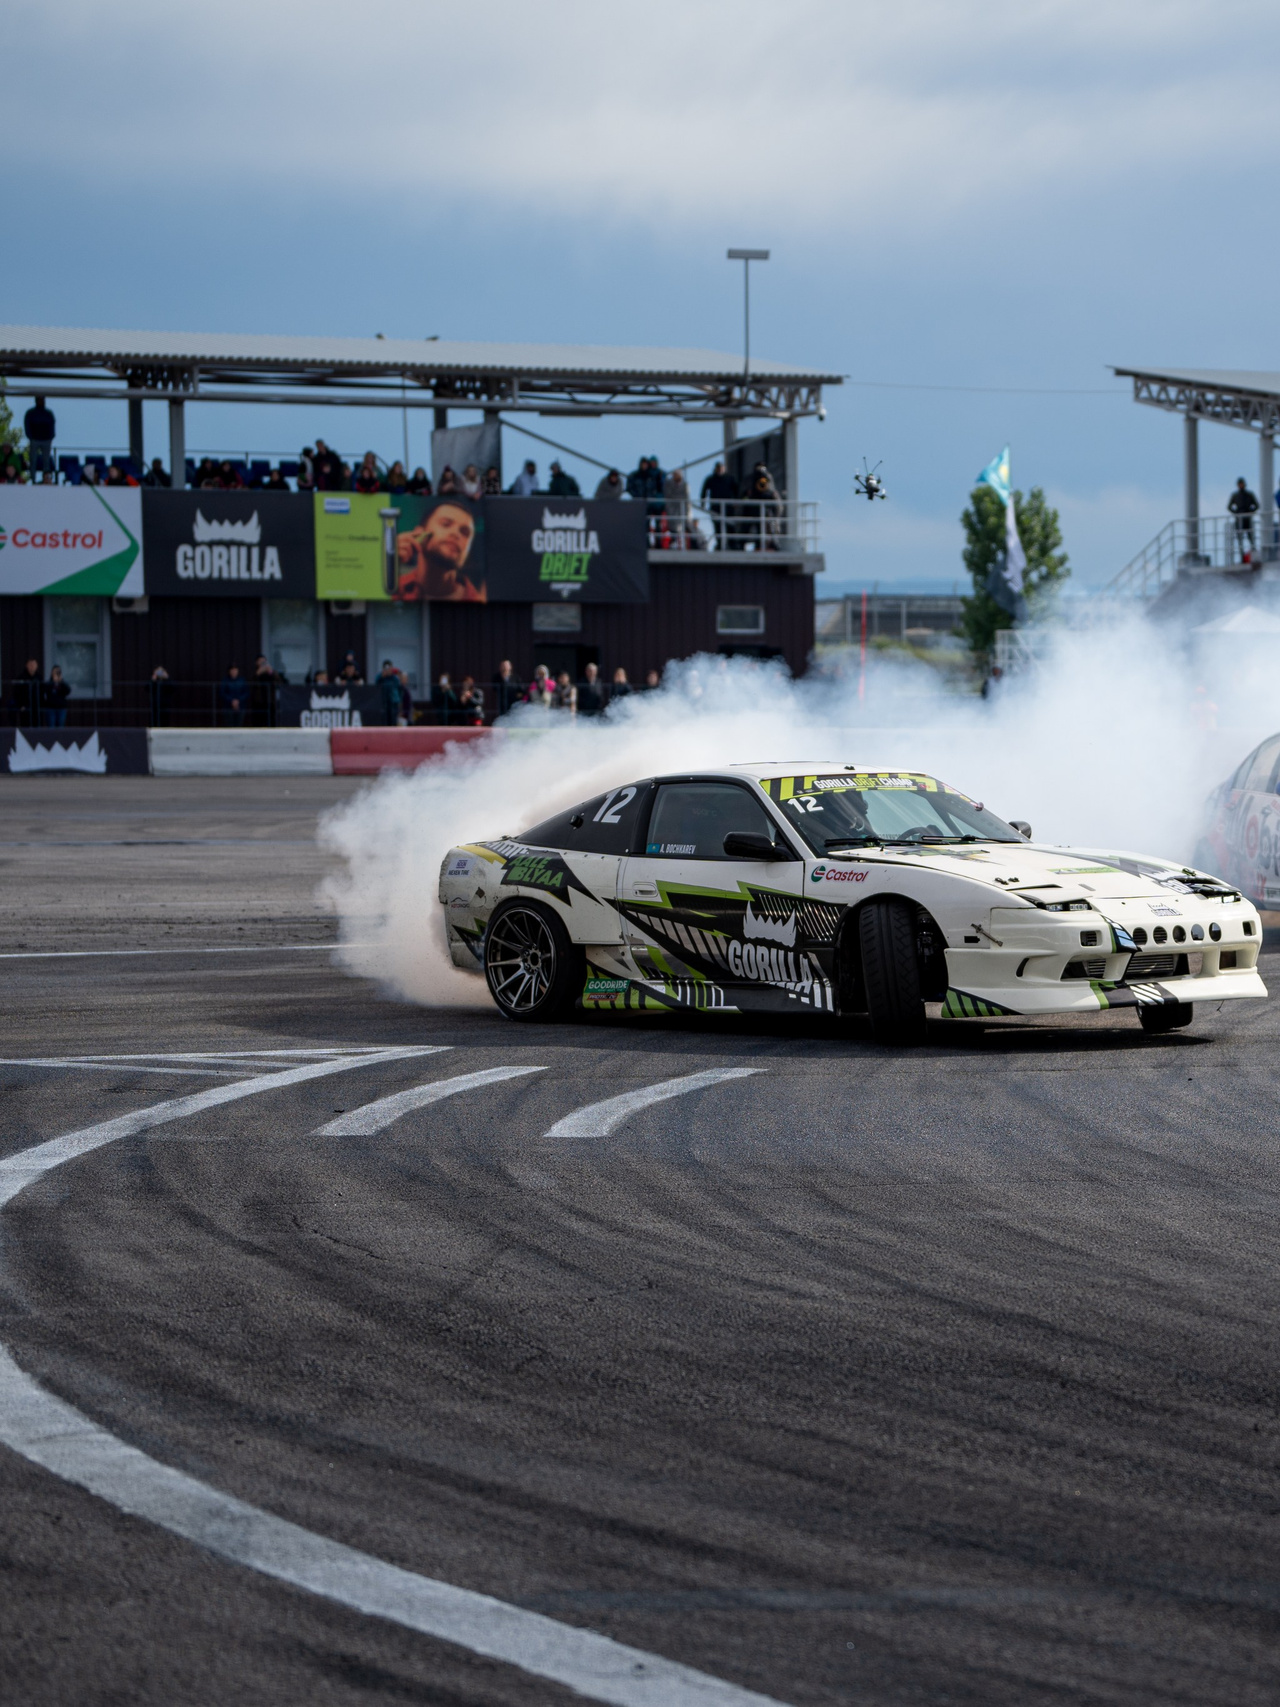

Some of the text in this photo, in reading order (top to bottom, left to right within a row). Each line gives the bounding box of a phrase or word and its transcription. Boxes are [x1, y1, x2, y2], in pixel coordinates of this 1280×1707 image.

[11, 528, 103, 549] Castrol
[531, 529, 600, 553] GORILLA
[176, 543, 282, 580] GORILLA
[540, 553, 592, 579] DRIFT
[300, 710, 362, 728] GORILLA
[813, 777, 857, 789] GORILLA
[853, 777, 881, 787] DRIFT
[879, 778, 913, 787] CHAMP
[592, 786, 637, 824] 12
[787, 796, 824, 814] 12
[665, 843, 696, 854] BOCHKAREV
[825, 868, 869, 883] Castrol
[728, 939, 813, 994] GORILLA
[588, 980, 628, 989] GOODRIDE
